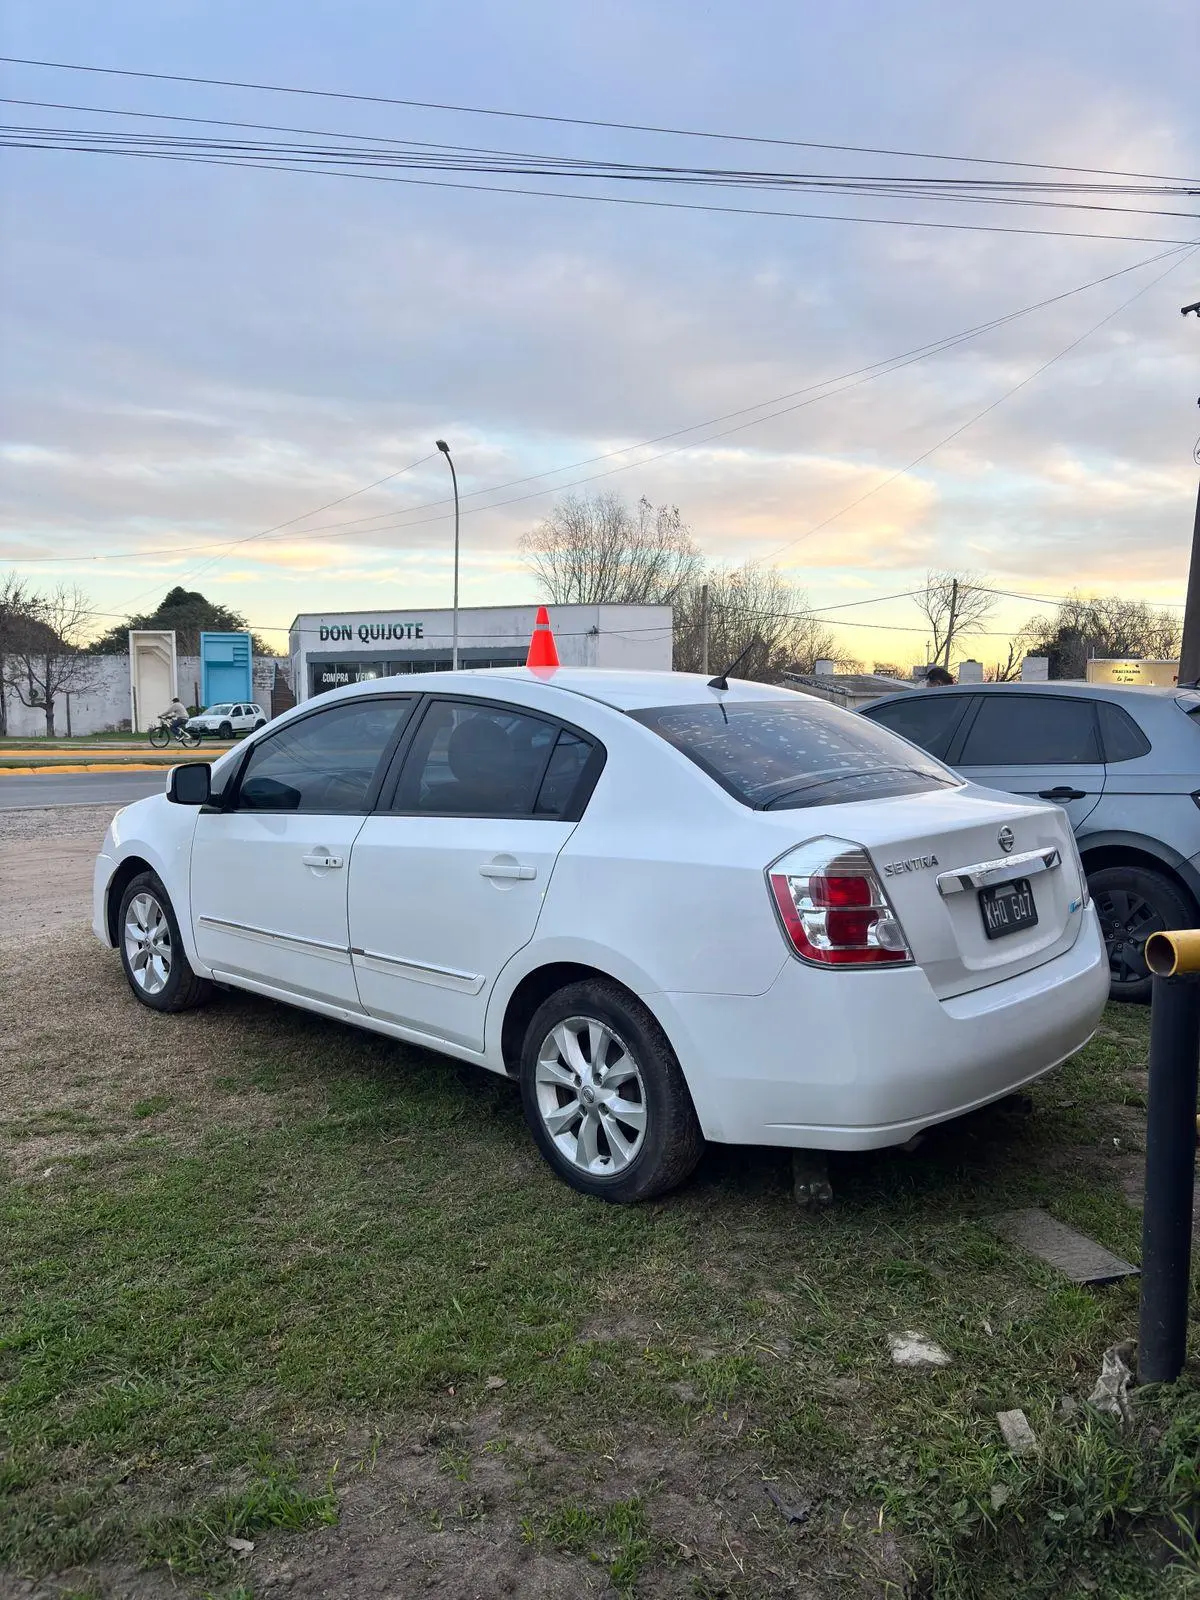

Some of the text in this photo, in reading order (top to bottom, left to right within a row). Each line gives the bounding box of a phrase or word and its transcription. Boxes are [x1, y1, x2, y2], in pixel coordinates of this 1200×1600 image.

[320, 622, 424, 644] DON QUIJOTE
[322, 672, 349, 683] COMPRA
[884, 854, 939, 877] SENTRA
[1011, 892, 1032, 920] 647
